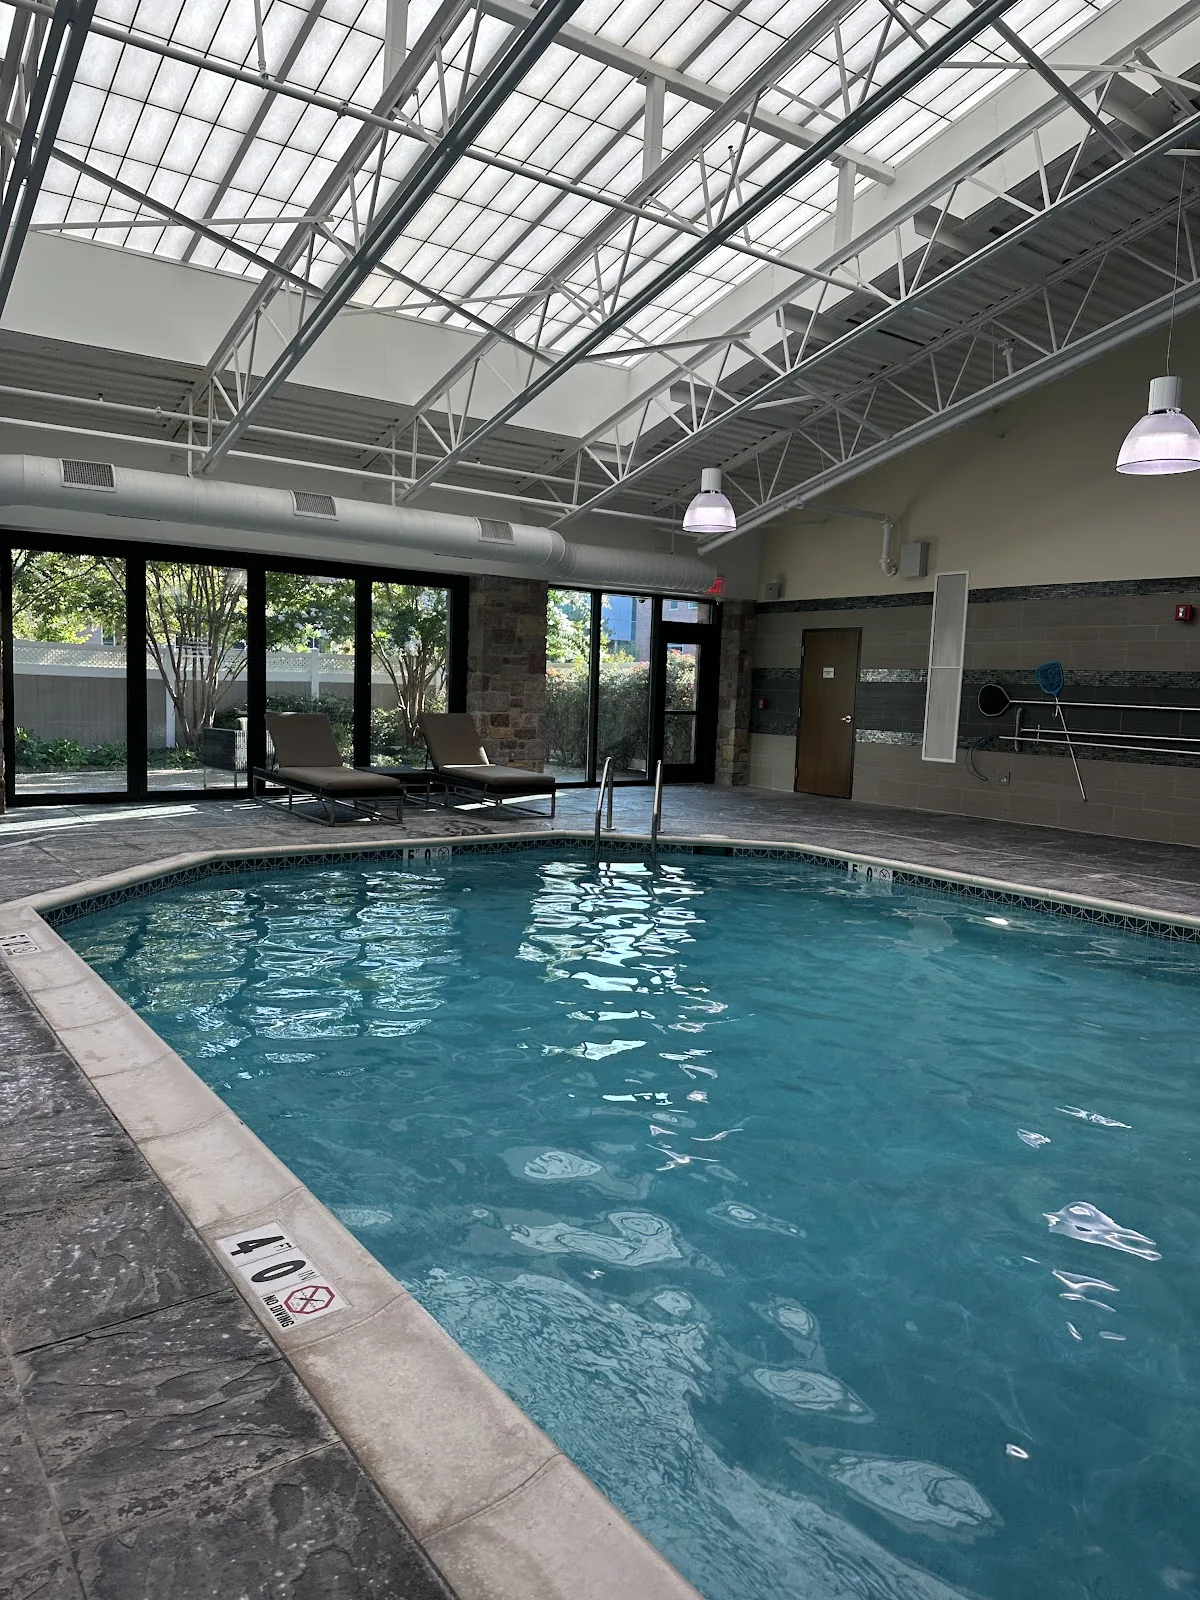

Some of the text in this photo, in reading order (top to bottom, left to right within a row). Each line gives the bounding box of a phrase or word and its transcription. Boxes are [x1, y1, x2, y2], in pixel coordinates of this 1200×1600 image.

[424, 848, 431, 859] 0
[866, 866, 873, 878] 0
[231, 1235, 317, 1283] 4 FT 0 IN
[262, 1294, 295, 1328] NO DIVING
